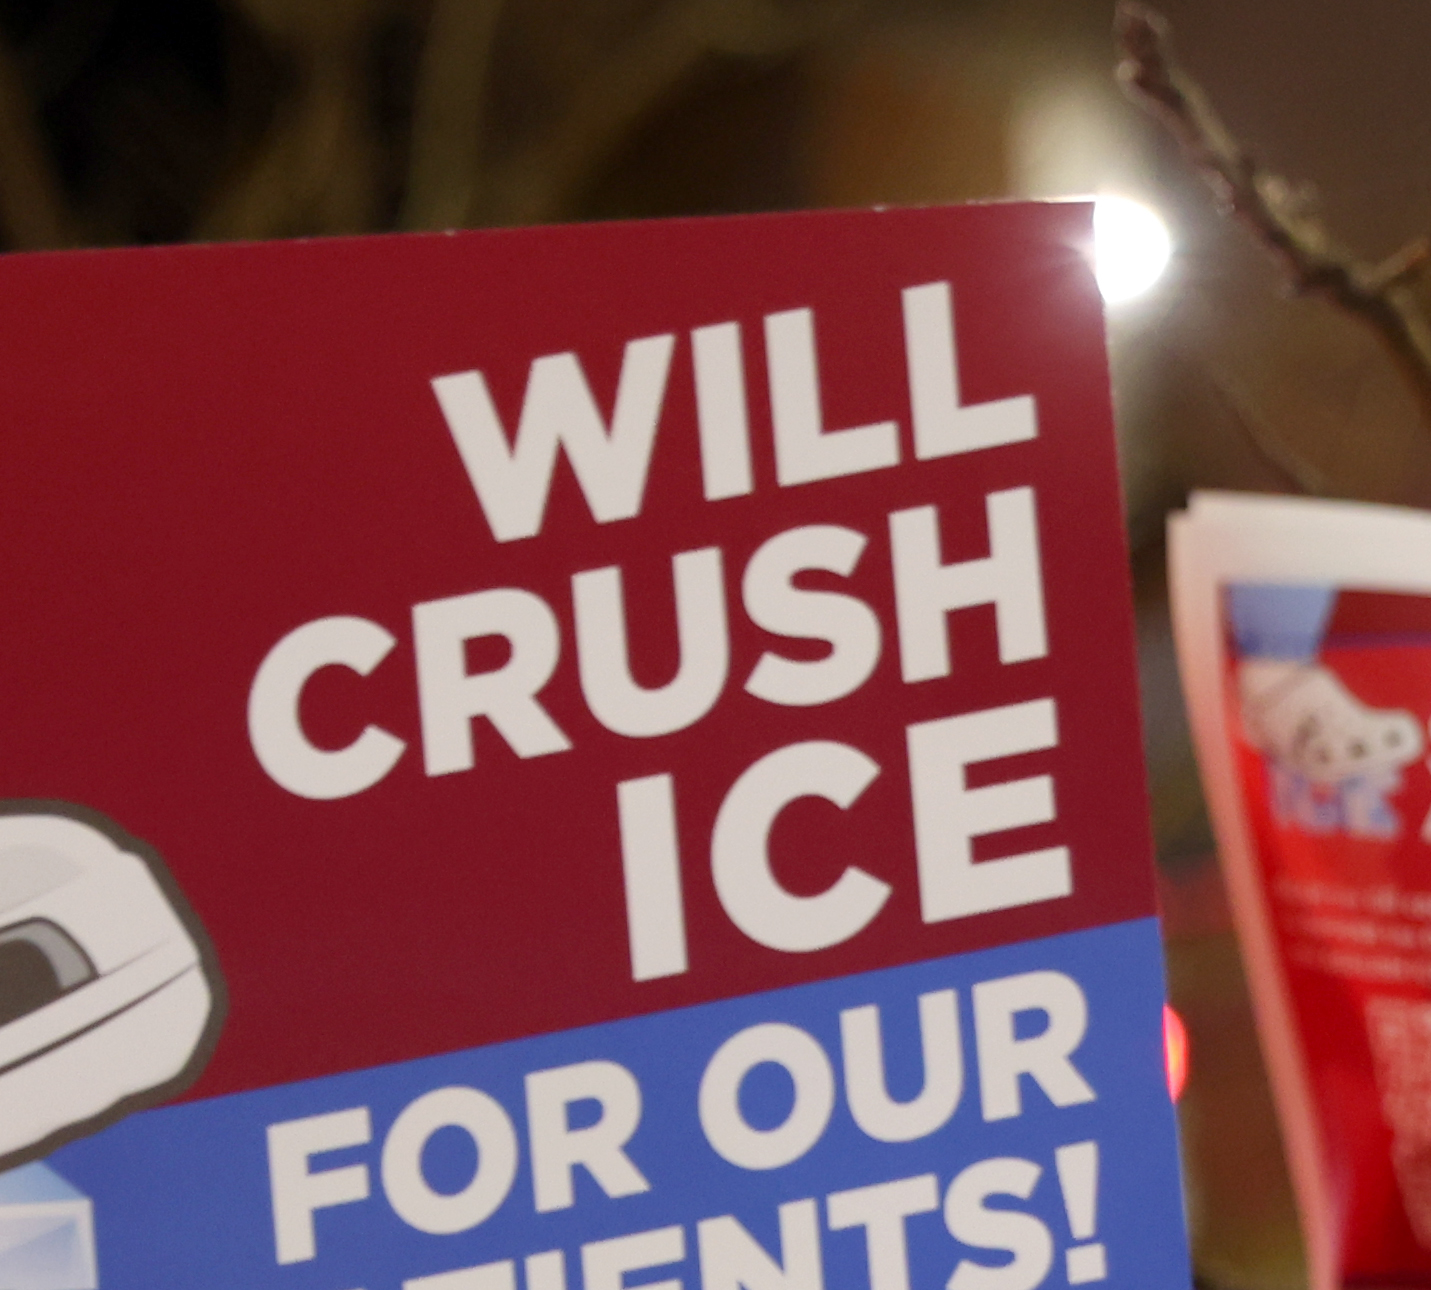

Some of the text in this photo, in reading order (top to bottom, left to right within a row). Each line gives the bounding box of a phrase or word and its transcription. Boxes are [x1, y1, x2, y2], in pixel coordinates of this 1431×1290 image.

[431, 280, 1039, 543] WILL
[247, 486, 1048, 800] CRUSH
[616, 697, 1073, 982] ICE
[266, 968, 1097, 1266] FOR OUR
